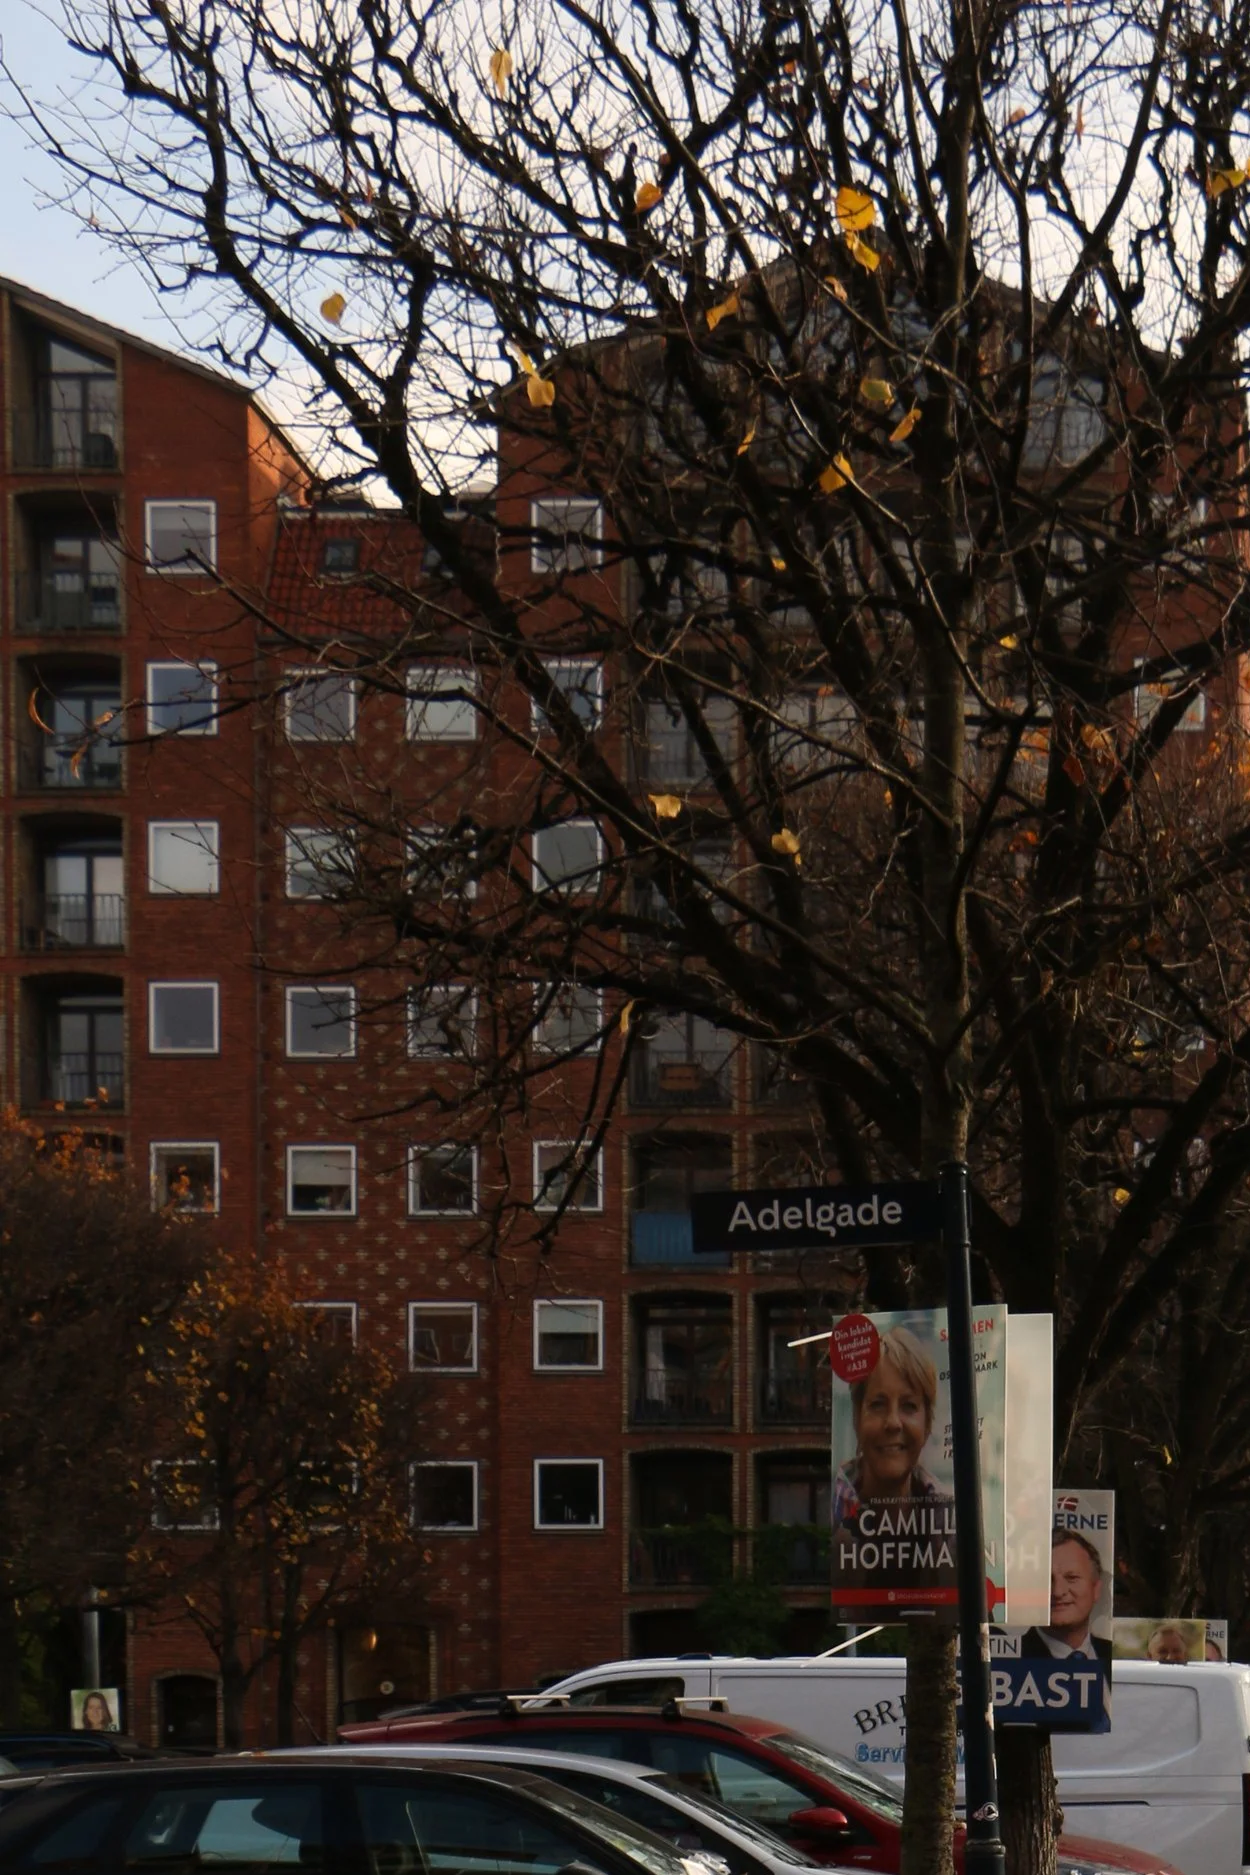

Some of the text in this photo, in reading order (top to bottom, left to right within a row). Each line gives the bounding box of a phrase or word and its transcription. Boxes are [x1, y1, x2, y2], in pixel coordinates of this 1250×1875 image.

[728, 1194, 903, 1238] Adelgade
[834, 1322, 872, 1341] Din lokale
[838, 1337, 871, 1352] kandidat
[859, 1508, 957, 1537] CAMILL
[1053, 1513, 1108, 1531] ERNE
[840, 1540, 997, 1570] HOFFMAN
[1206, 1630, 1225, 1639] RNE
[988, 1637, 1018, 1655] TIN
[956, 1671, 1097, 1708] BAST
[855, 1742, 906, 1763] Servi
